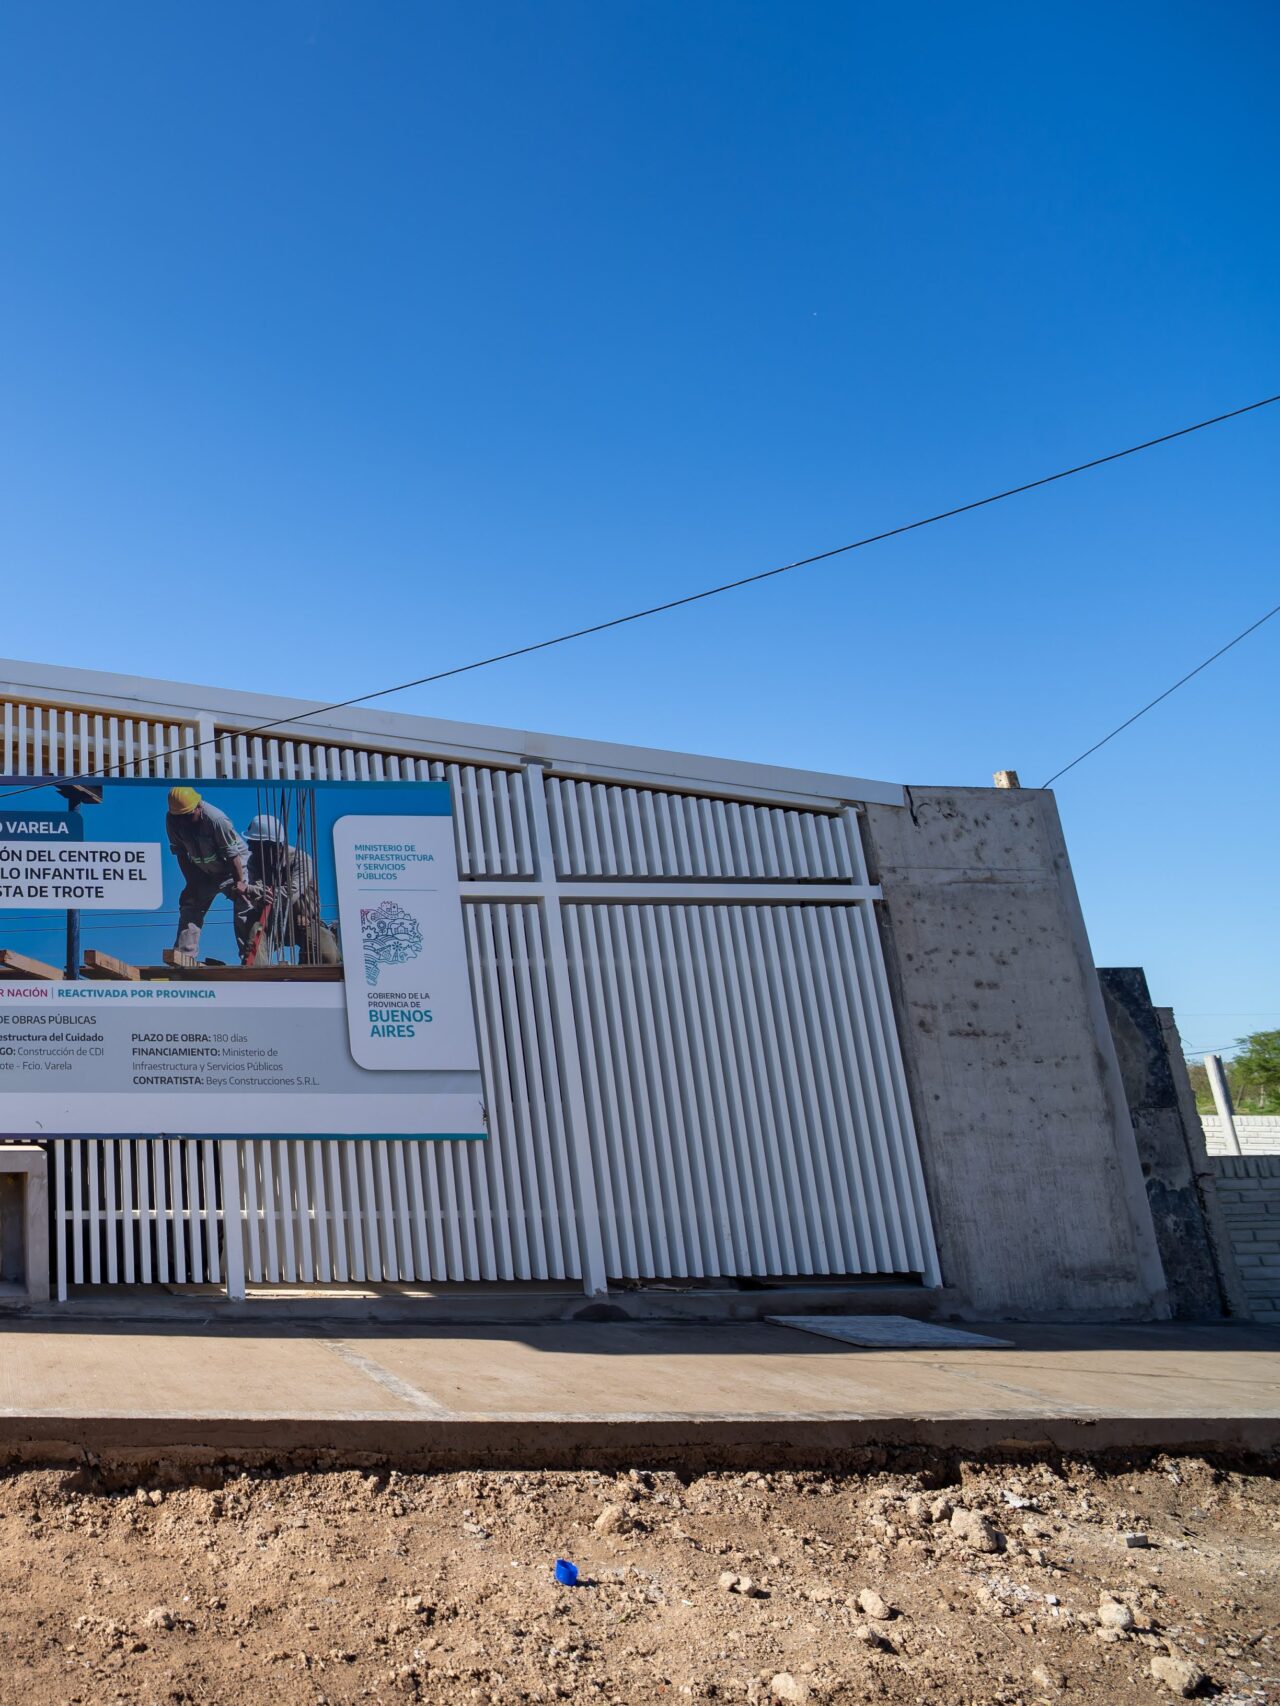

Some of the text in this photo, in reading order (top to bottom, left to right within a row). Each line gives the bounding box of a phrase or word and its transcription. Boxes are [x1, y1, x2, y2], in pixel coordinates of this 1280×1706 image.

[6, 821, 68, 834] VARELA
[26, 850, 55, 862] DEL
[59, 850, 120, 862] CENTRO
[124, 851, 145, 863] DE
[25, 868, 98, 880] INFANTIL
[103, 869, 124, 880] EN
[128, 869, 147, 881] EL
[357, 871, 397, 880] PÚBLICOS
[27, 886, 48, 898] DE
[52, 886, 104, 898] TROTE
[7, 987, 48, 997] NACIÓN
[58, 989, 128, 998] REACTIVADA
[130, 990, 154, 998] POR
[156, 990, 216, 999] PROVINCIA
[12, 1016, 46, 1024] OBRAS
[48, 1014, 96, 1024] PÚBLICAS
[369, 1010, 433, 1022] BUENOS
[371, 1025, 415, 1037] AIRES
[50, 1033, 64, 1042] del
[65, 1033, 103, 1042] Cuidado
[132, 1034, 248, 1042] PLAZO DE OBRA: 180 días
[18, 1047, 74, 1056] Construcción
[76, 1047, 87, 1056] de
[89, 1048, 104, 1056] CDI
[132, 1048, 278, 1056] FINANCIAMIENTO: Ministerio de
[22, 1062, 42, 1070] Fcio.
[44, 1062, 72, 1070] Varela
[133, 1062, 283, 1072] Infraestructura y Servicios Públicos
[133, 1076, 320, 1087] CONTRATISTA: Beys Construcciones S.R.L.
